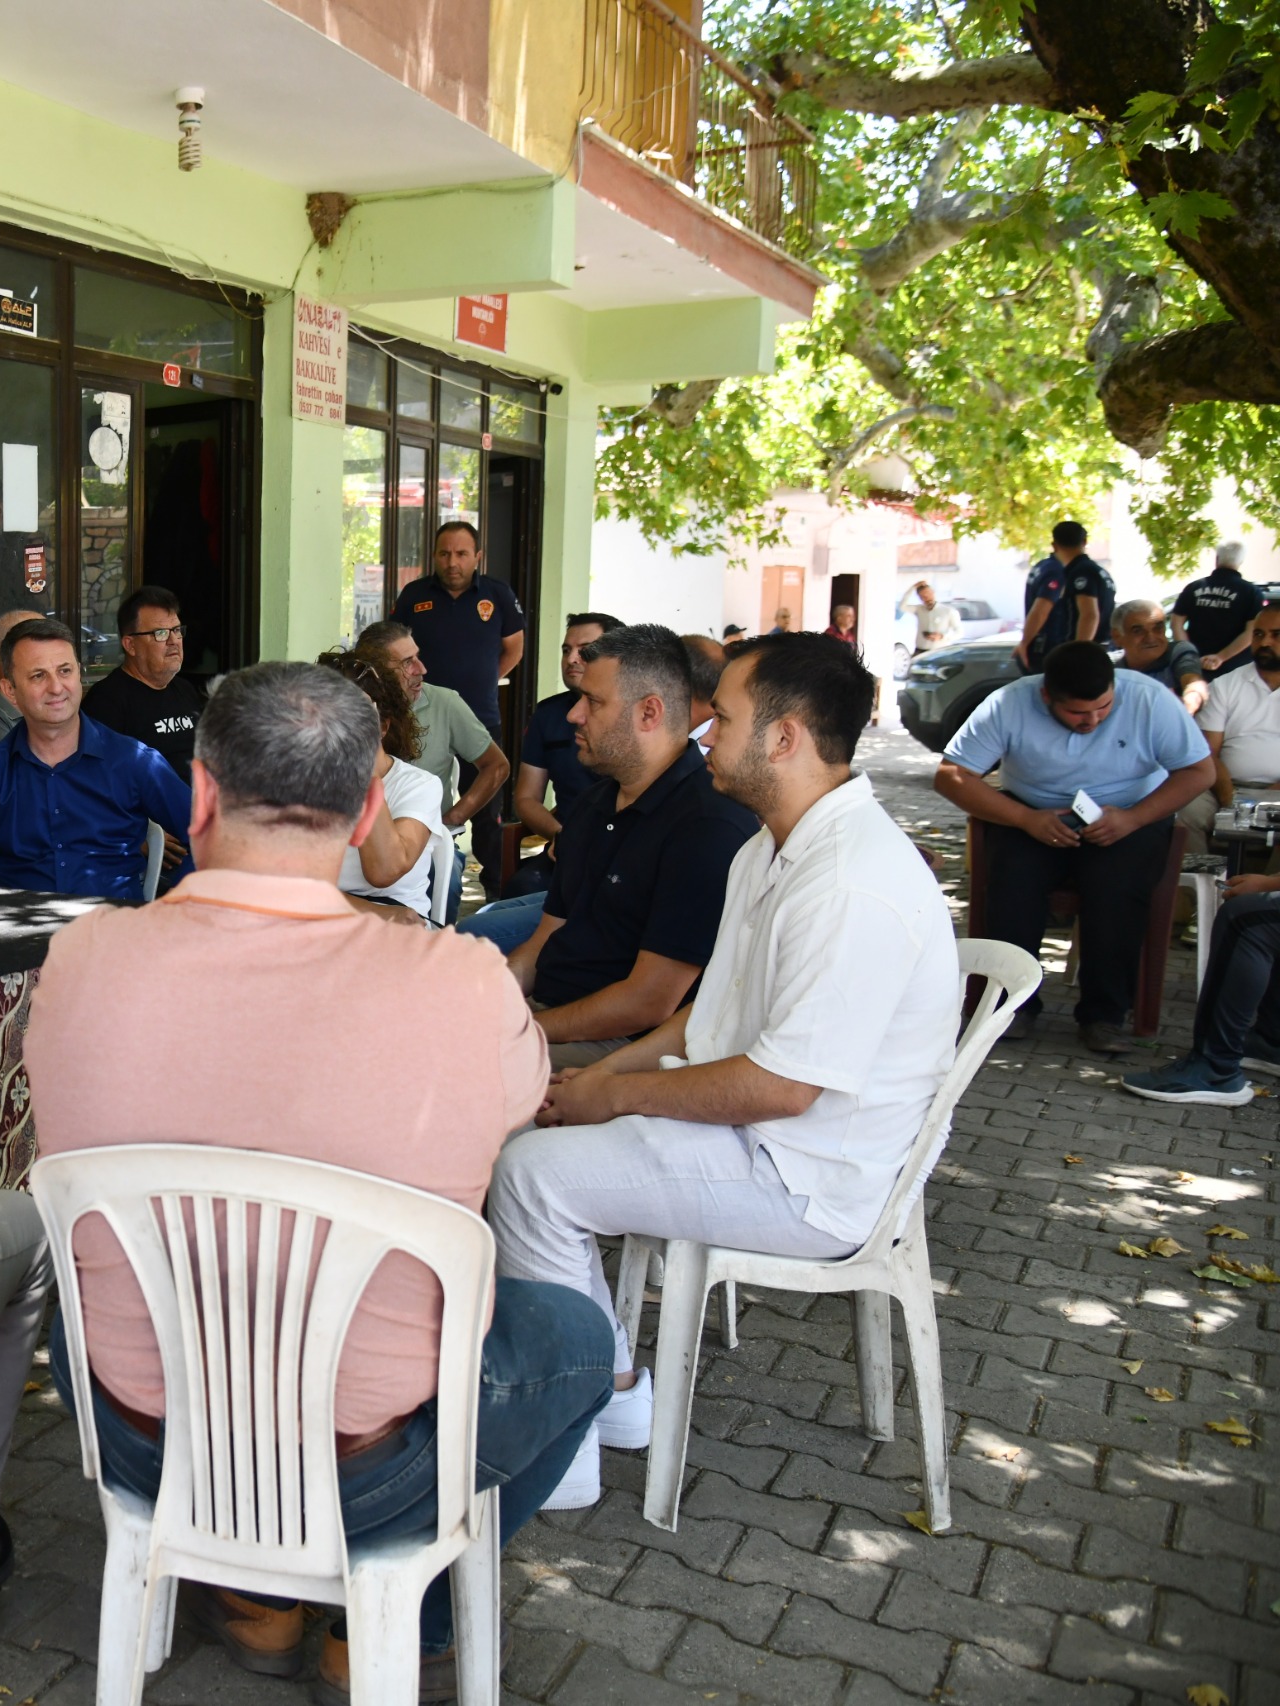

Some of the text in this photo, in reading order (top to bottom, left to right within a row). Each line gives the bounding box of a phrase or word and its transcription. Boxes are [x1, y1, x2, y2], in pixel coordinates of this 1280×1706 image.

[298, 330, 331, 356] KAHVESİ
[296, 358, 337, 385] BAKKALİYE
[296, 382, 322, 401] fahrettin
